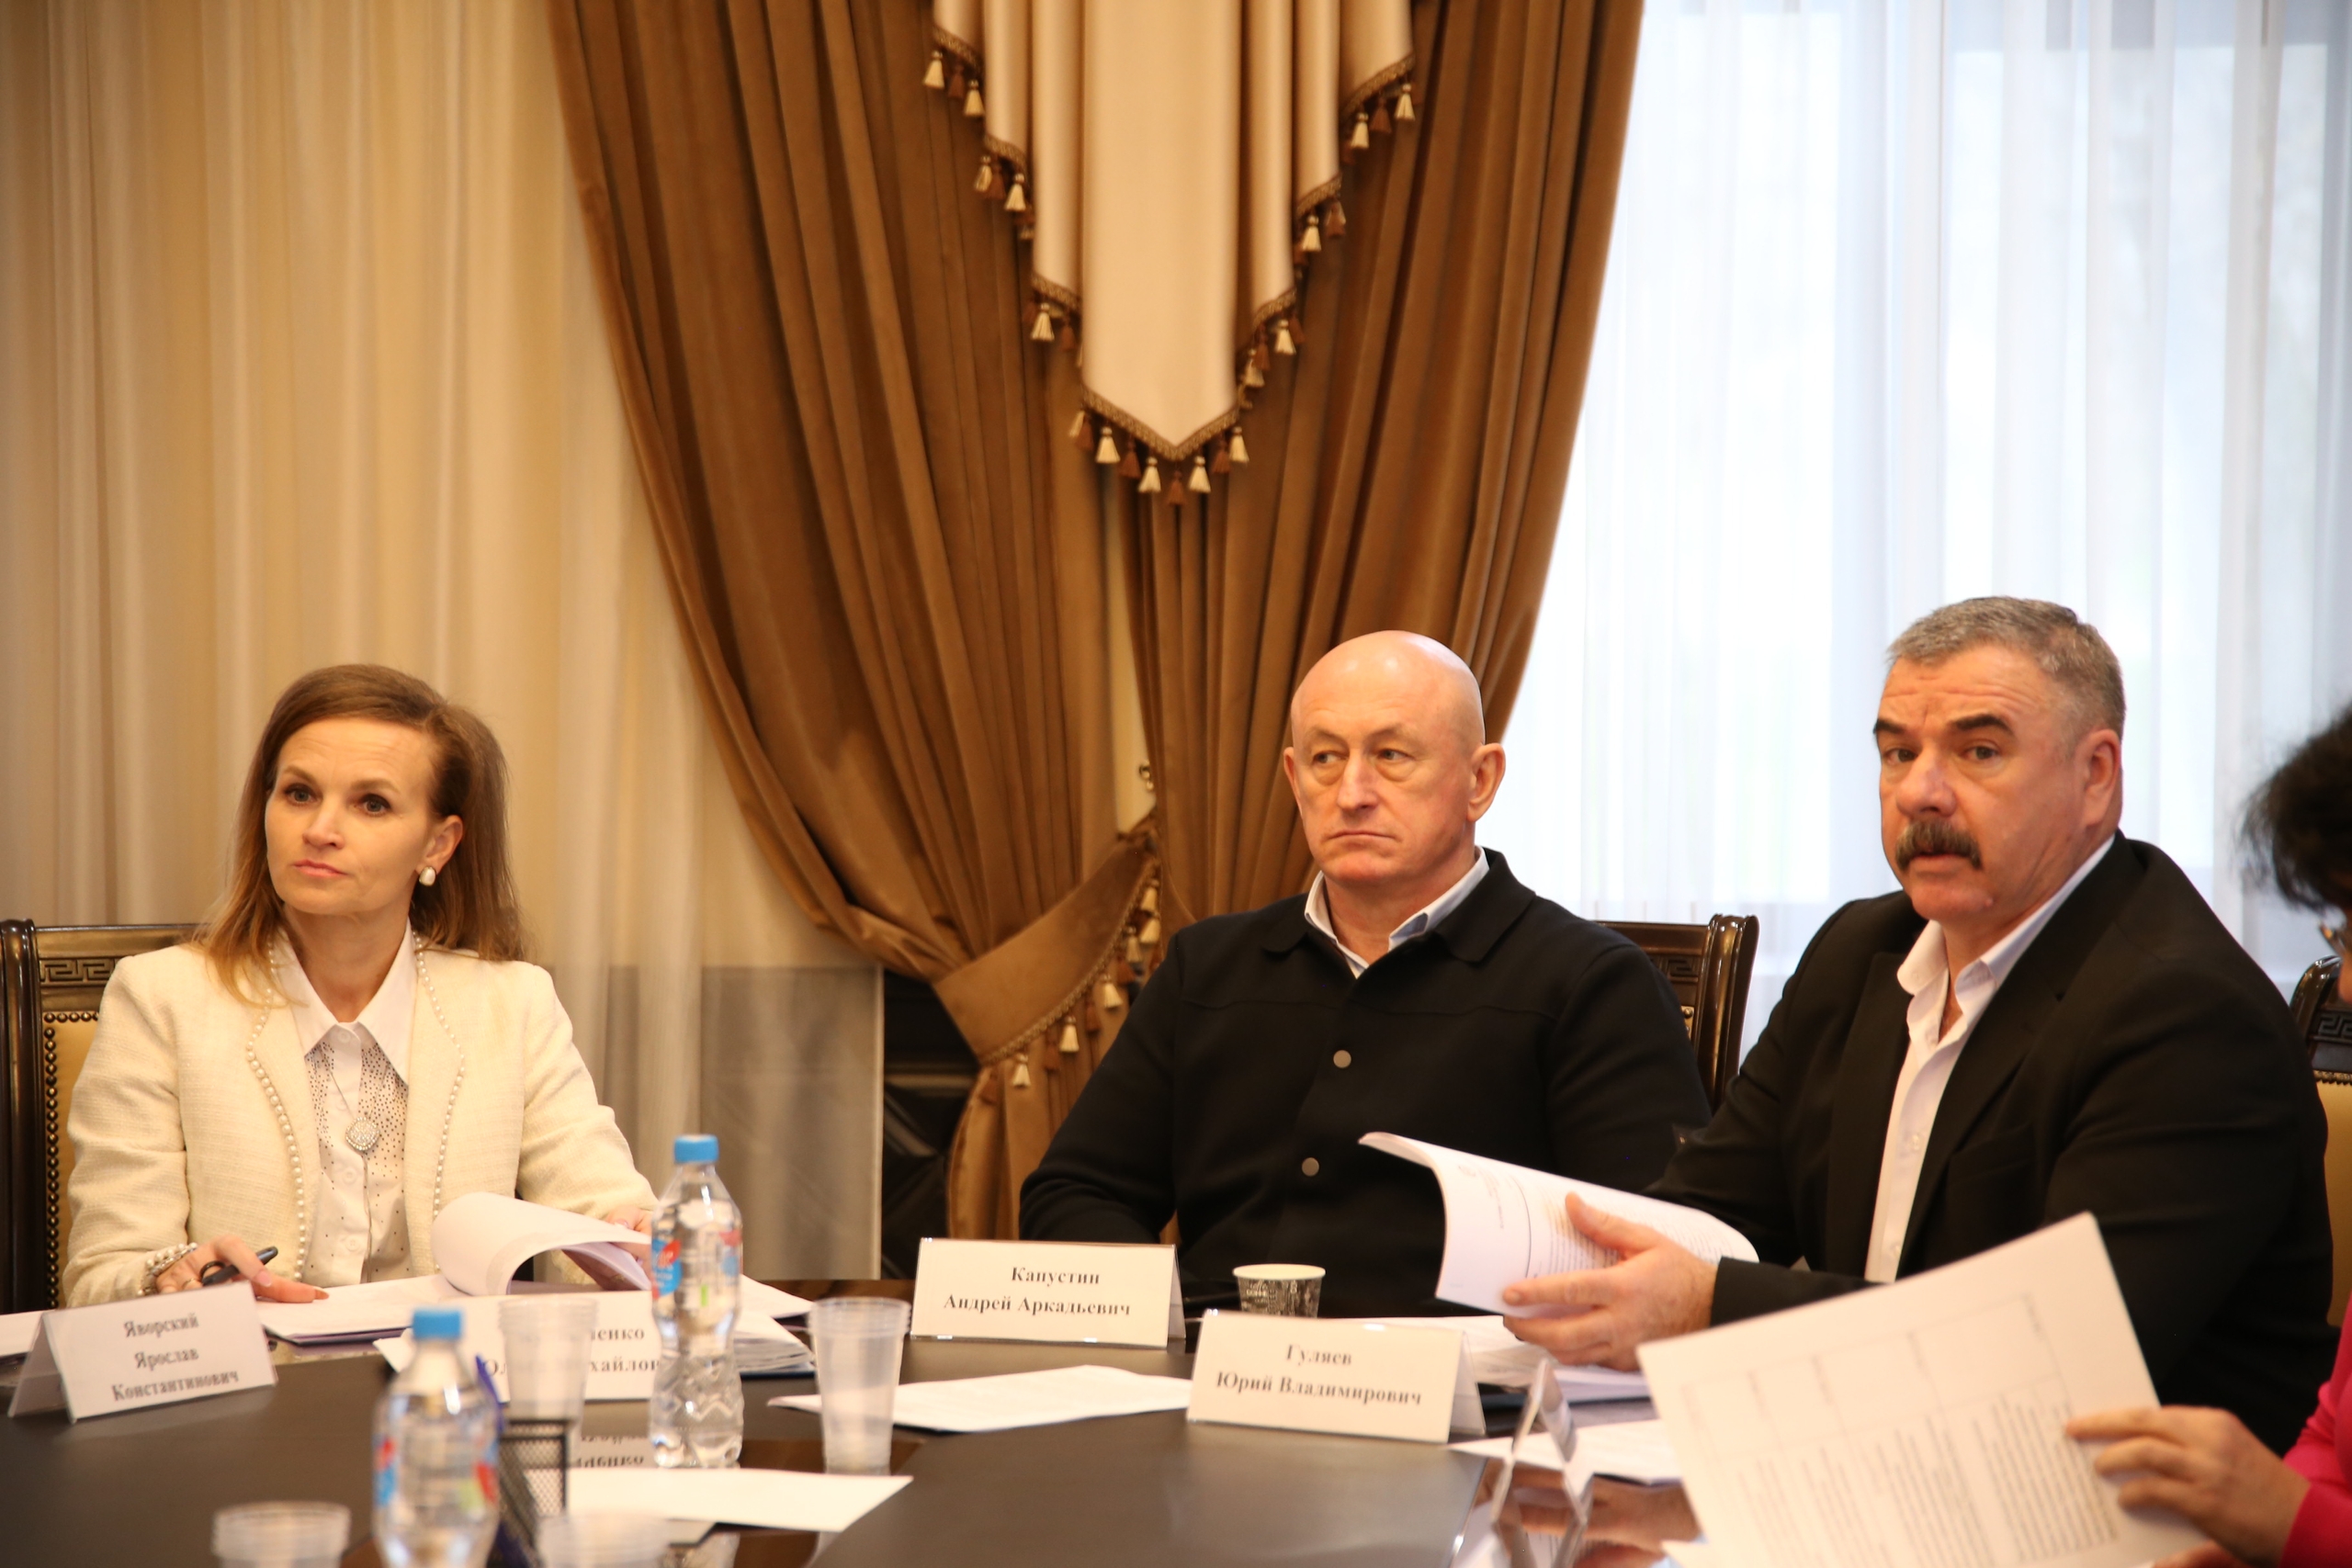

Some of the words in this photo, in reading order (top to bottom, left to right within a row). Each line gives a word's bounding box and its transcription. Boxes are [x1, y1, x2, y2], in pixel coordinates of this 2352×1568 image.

[1011, 1266, 1101, 1287] Капустин
[943, 1293, 1012, 1314] Андрей
[1017, 1296, 1131, 1316] Аркадьевич
[124, 1313, 198, 1338] Яворский
[133, 1348, 200, 1371] Ярослав
[1285, 1343, 1353, 1367] Гуляев
[111, 1371, 239, 1401] Константинович
[1216, 1371, 1273, 1394] Юрий
[1279, 1376, 1422, 1406] Владимирович
